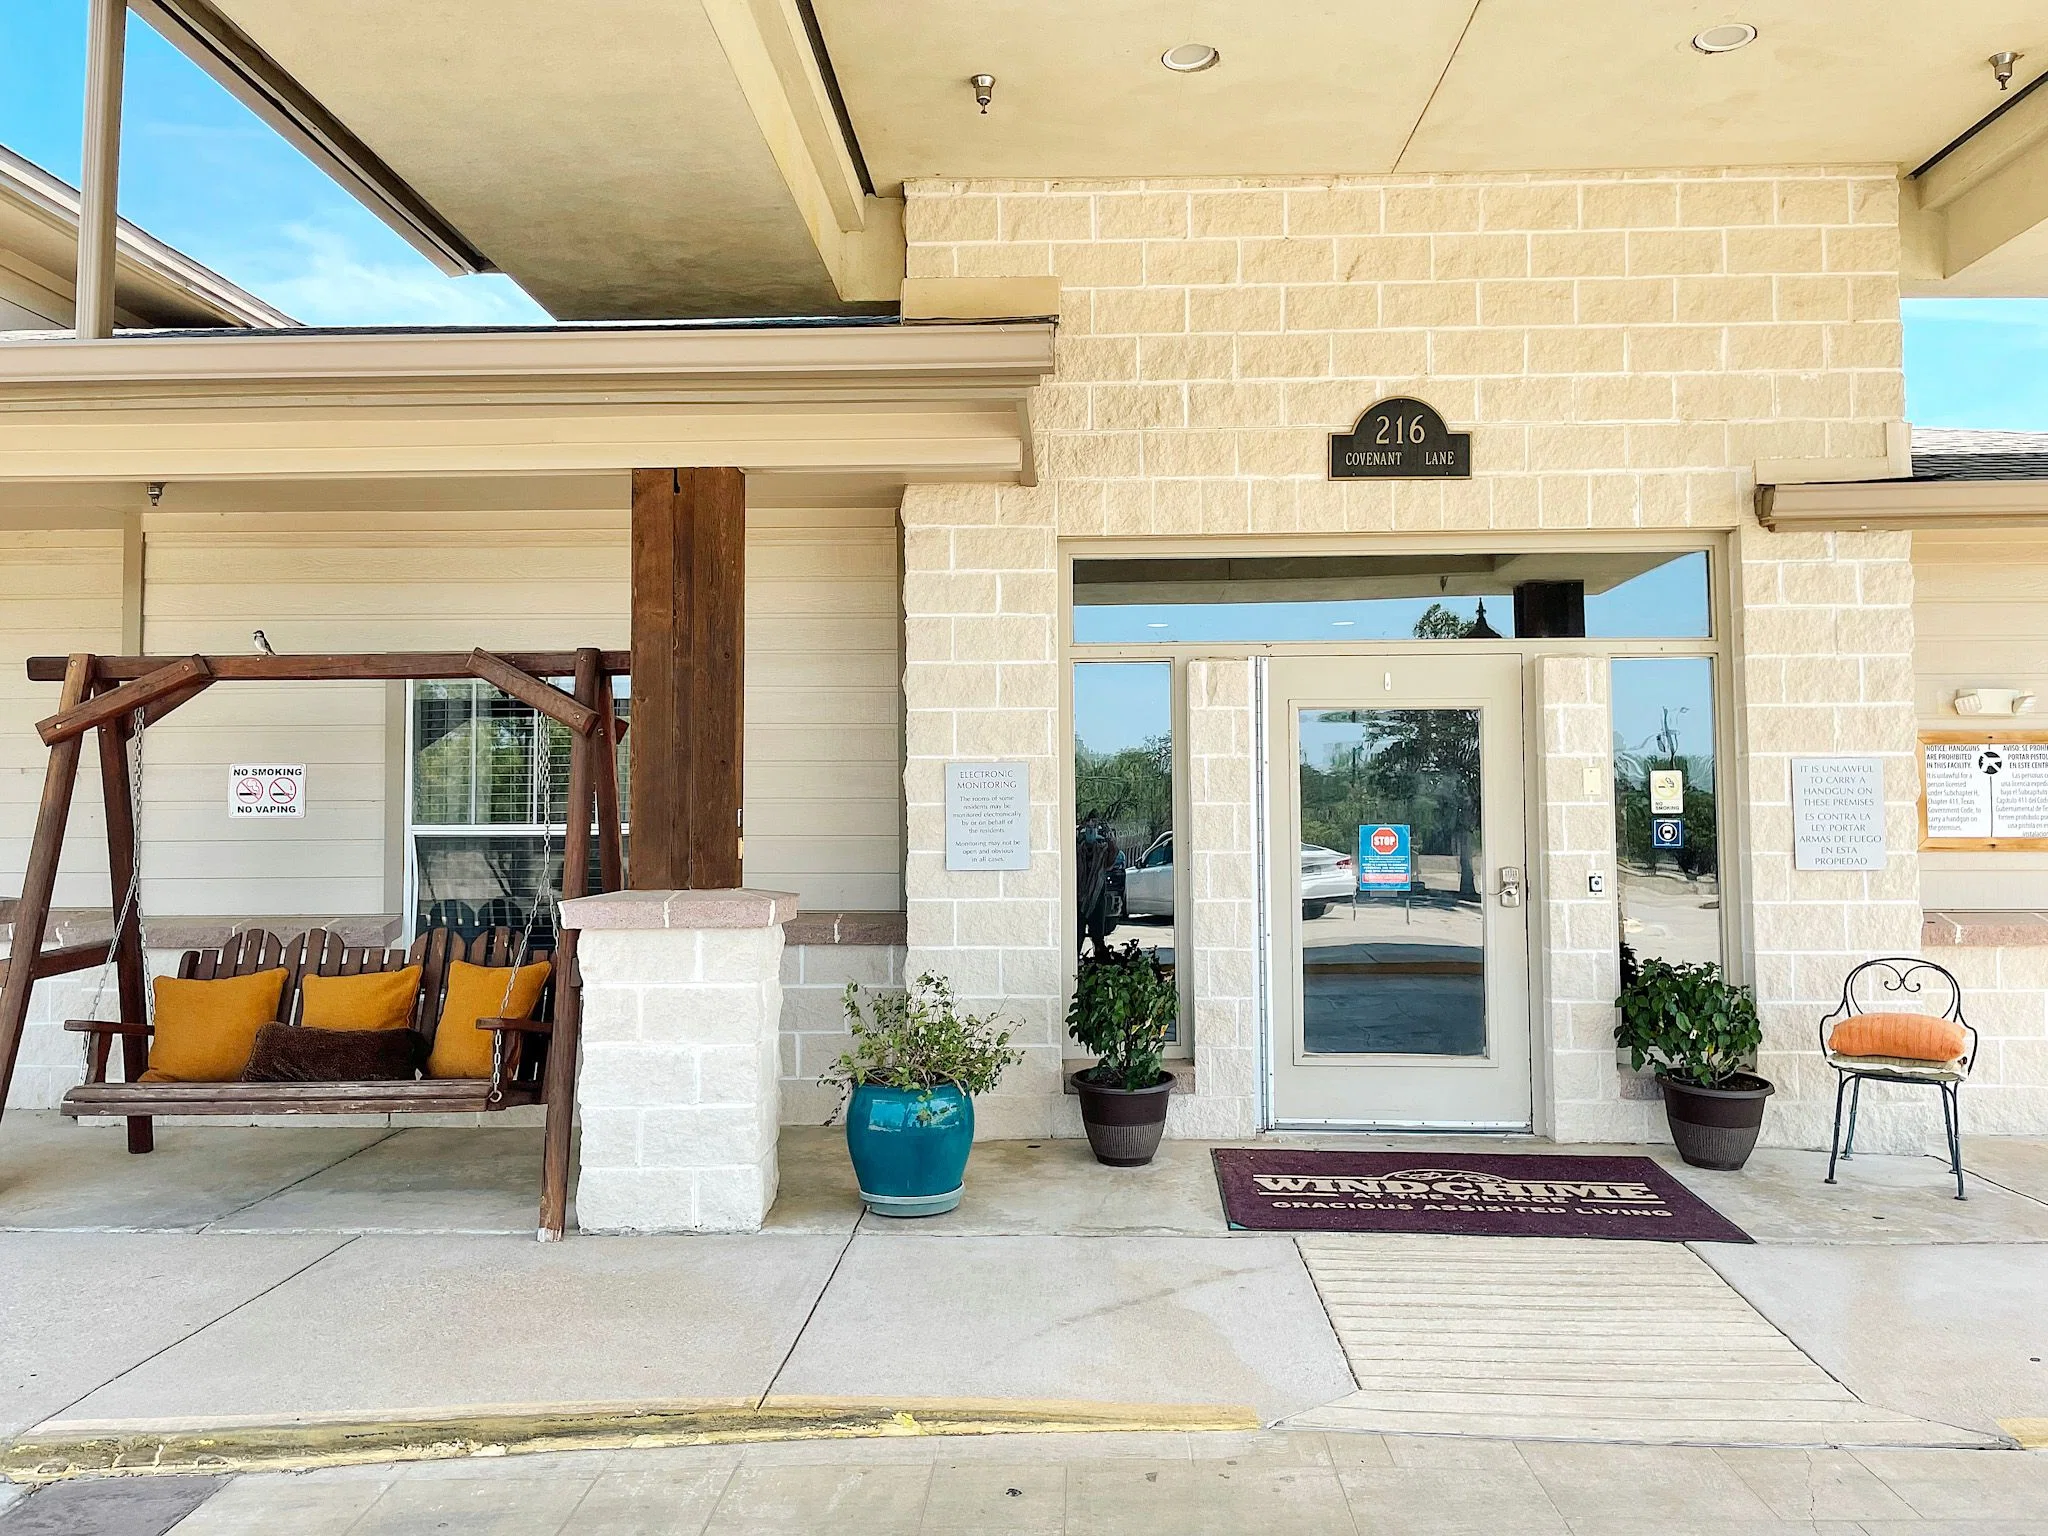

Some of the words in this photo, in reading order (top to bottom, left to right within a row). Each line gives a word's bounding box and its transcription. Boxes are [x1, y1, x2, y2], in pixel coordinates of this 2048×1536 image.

[1376, 414, 1425, 444] 216
[1346, 452, 1402, 466] COVENANT
[1425, 451, 1455, 465] LANE
[1373, 836, 1395, 846] STOP
[1253, 1177, 1659, 1199] WINDCHIME
[1453, 1195, 1569, 1203] VILLAGE
[1271, 1201, 1413, 1210] GRACIOUS
[1574, 1208, 1673, 1217] LIVING
